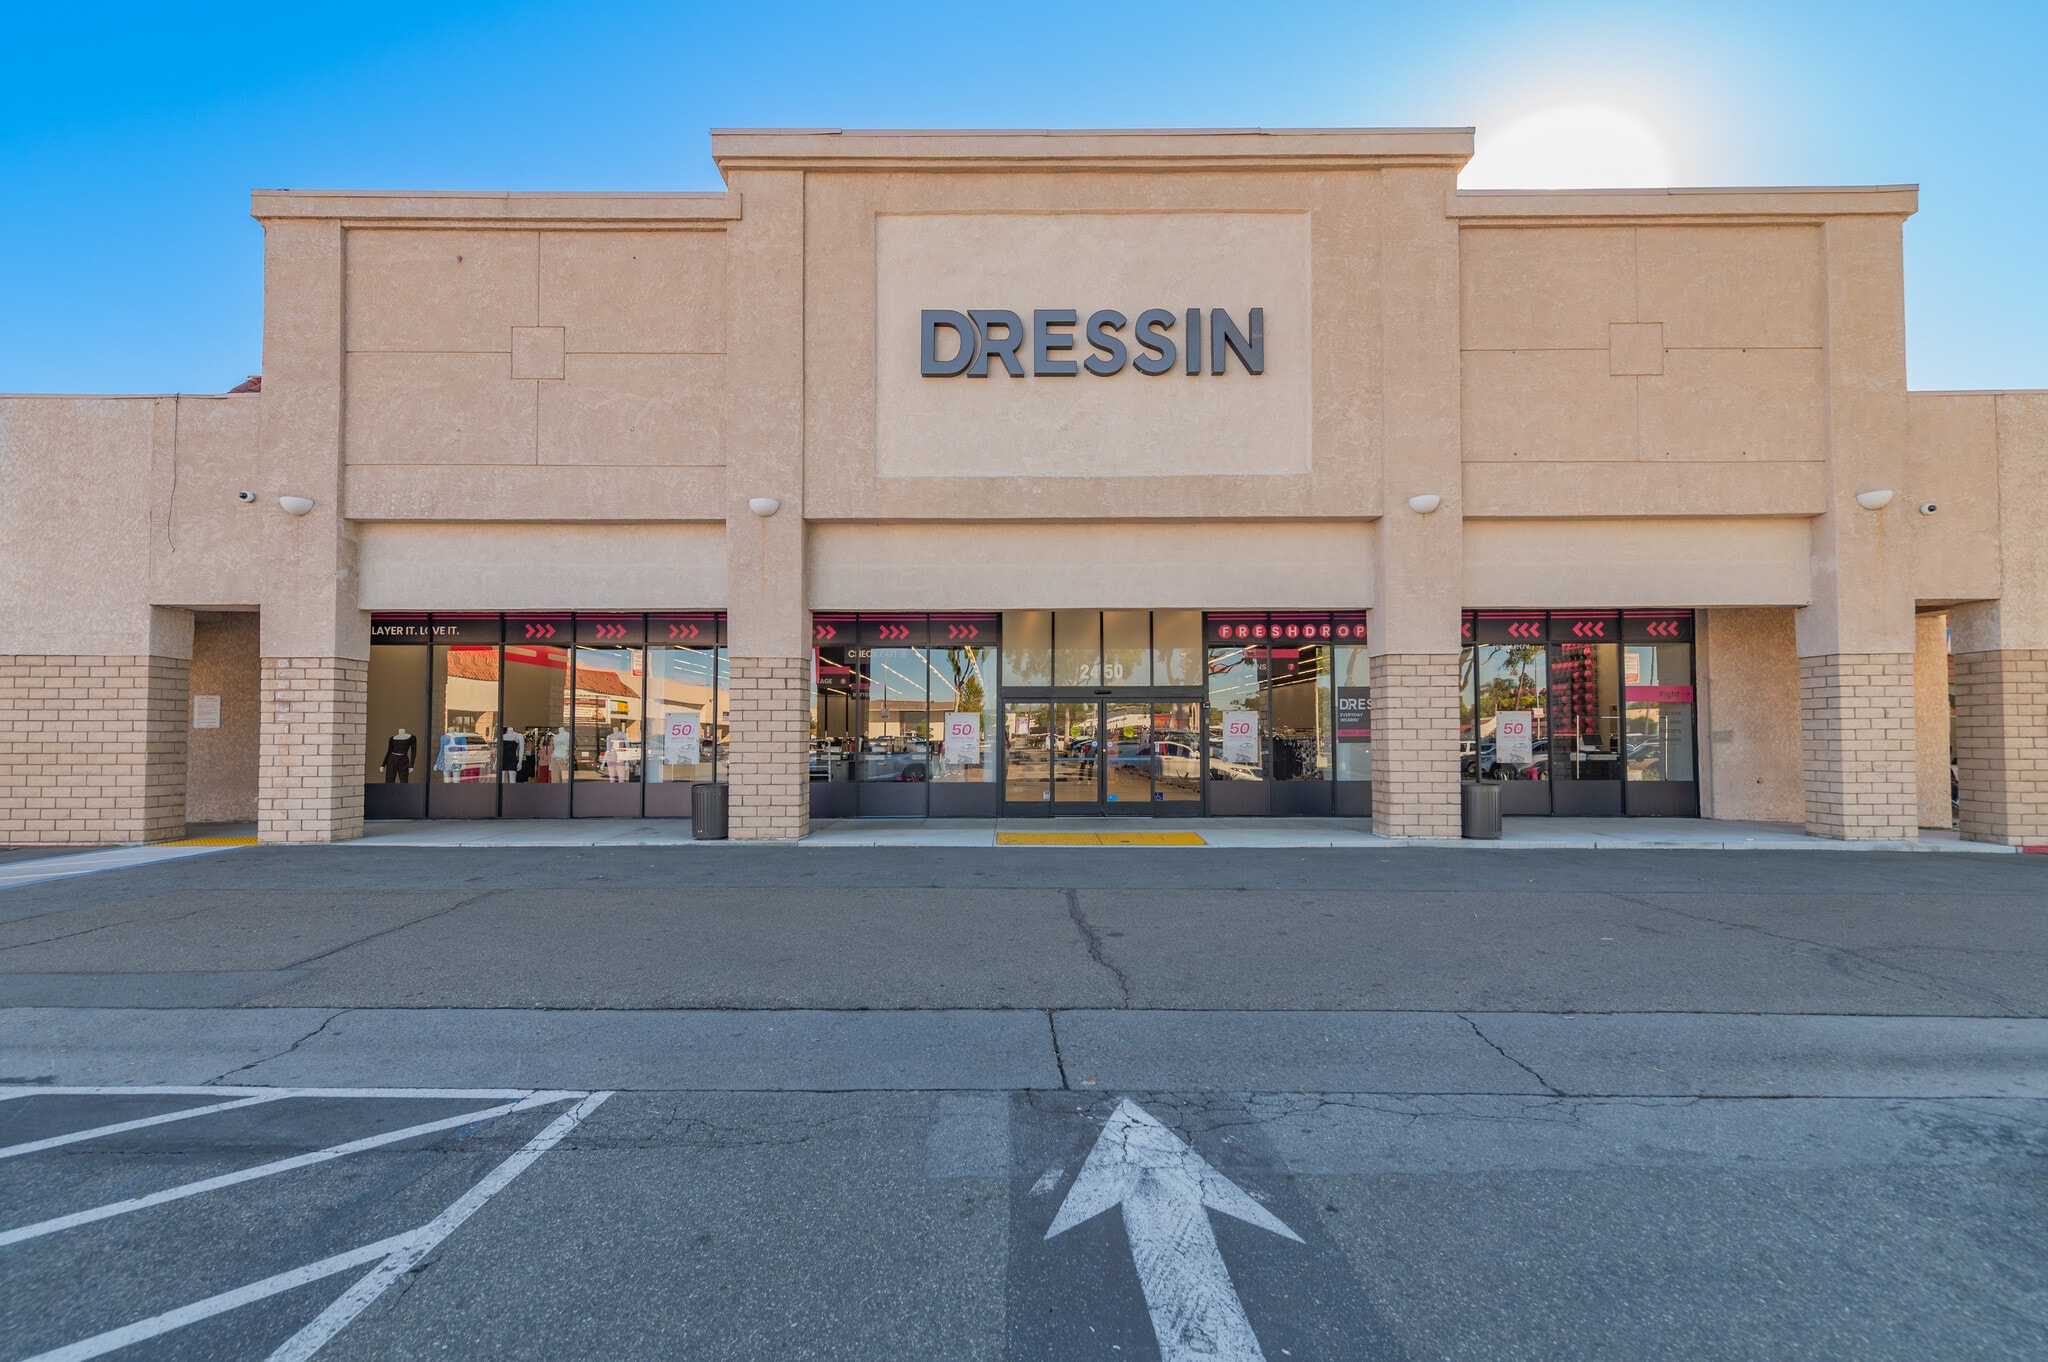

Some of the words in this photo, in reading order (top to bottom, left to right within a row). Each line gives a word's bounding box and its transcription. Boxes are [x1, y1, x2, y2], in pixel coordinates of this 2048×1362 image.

[921, 308, 1264, 378] DRESSIN
[372, 626, 403, 635] LAYER
[405, 626, 418, 635] IT.
[447, 626, 460, 635] IT.
[1222, 626, 1365, 637] FRESHDROP
[1079, 664, 1123, 679] 2450
[1659, 690, 1680, 699] Right
[671, 724, 692, 736] 50
[952, 724, 972, 735] 50
[1230, 722, 1250, 734] 50
[1503, 722, 1524, 734] 50
